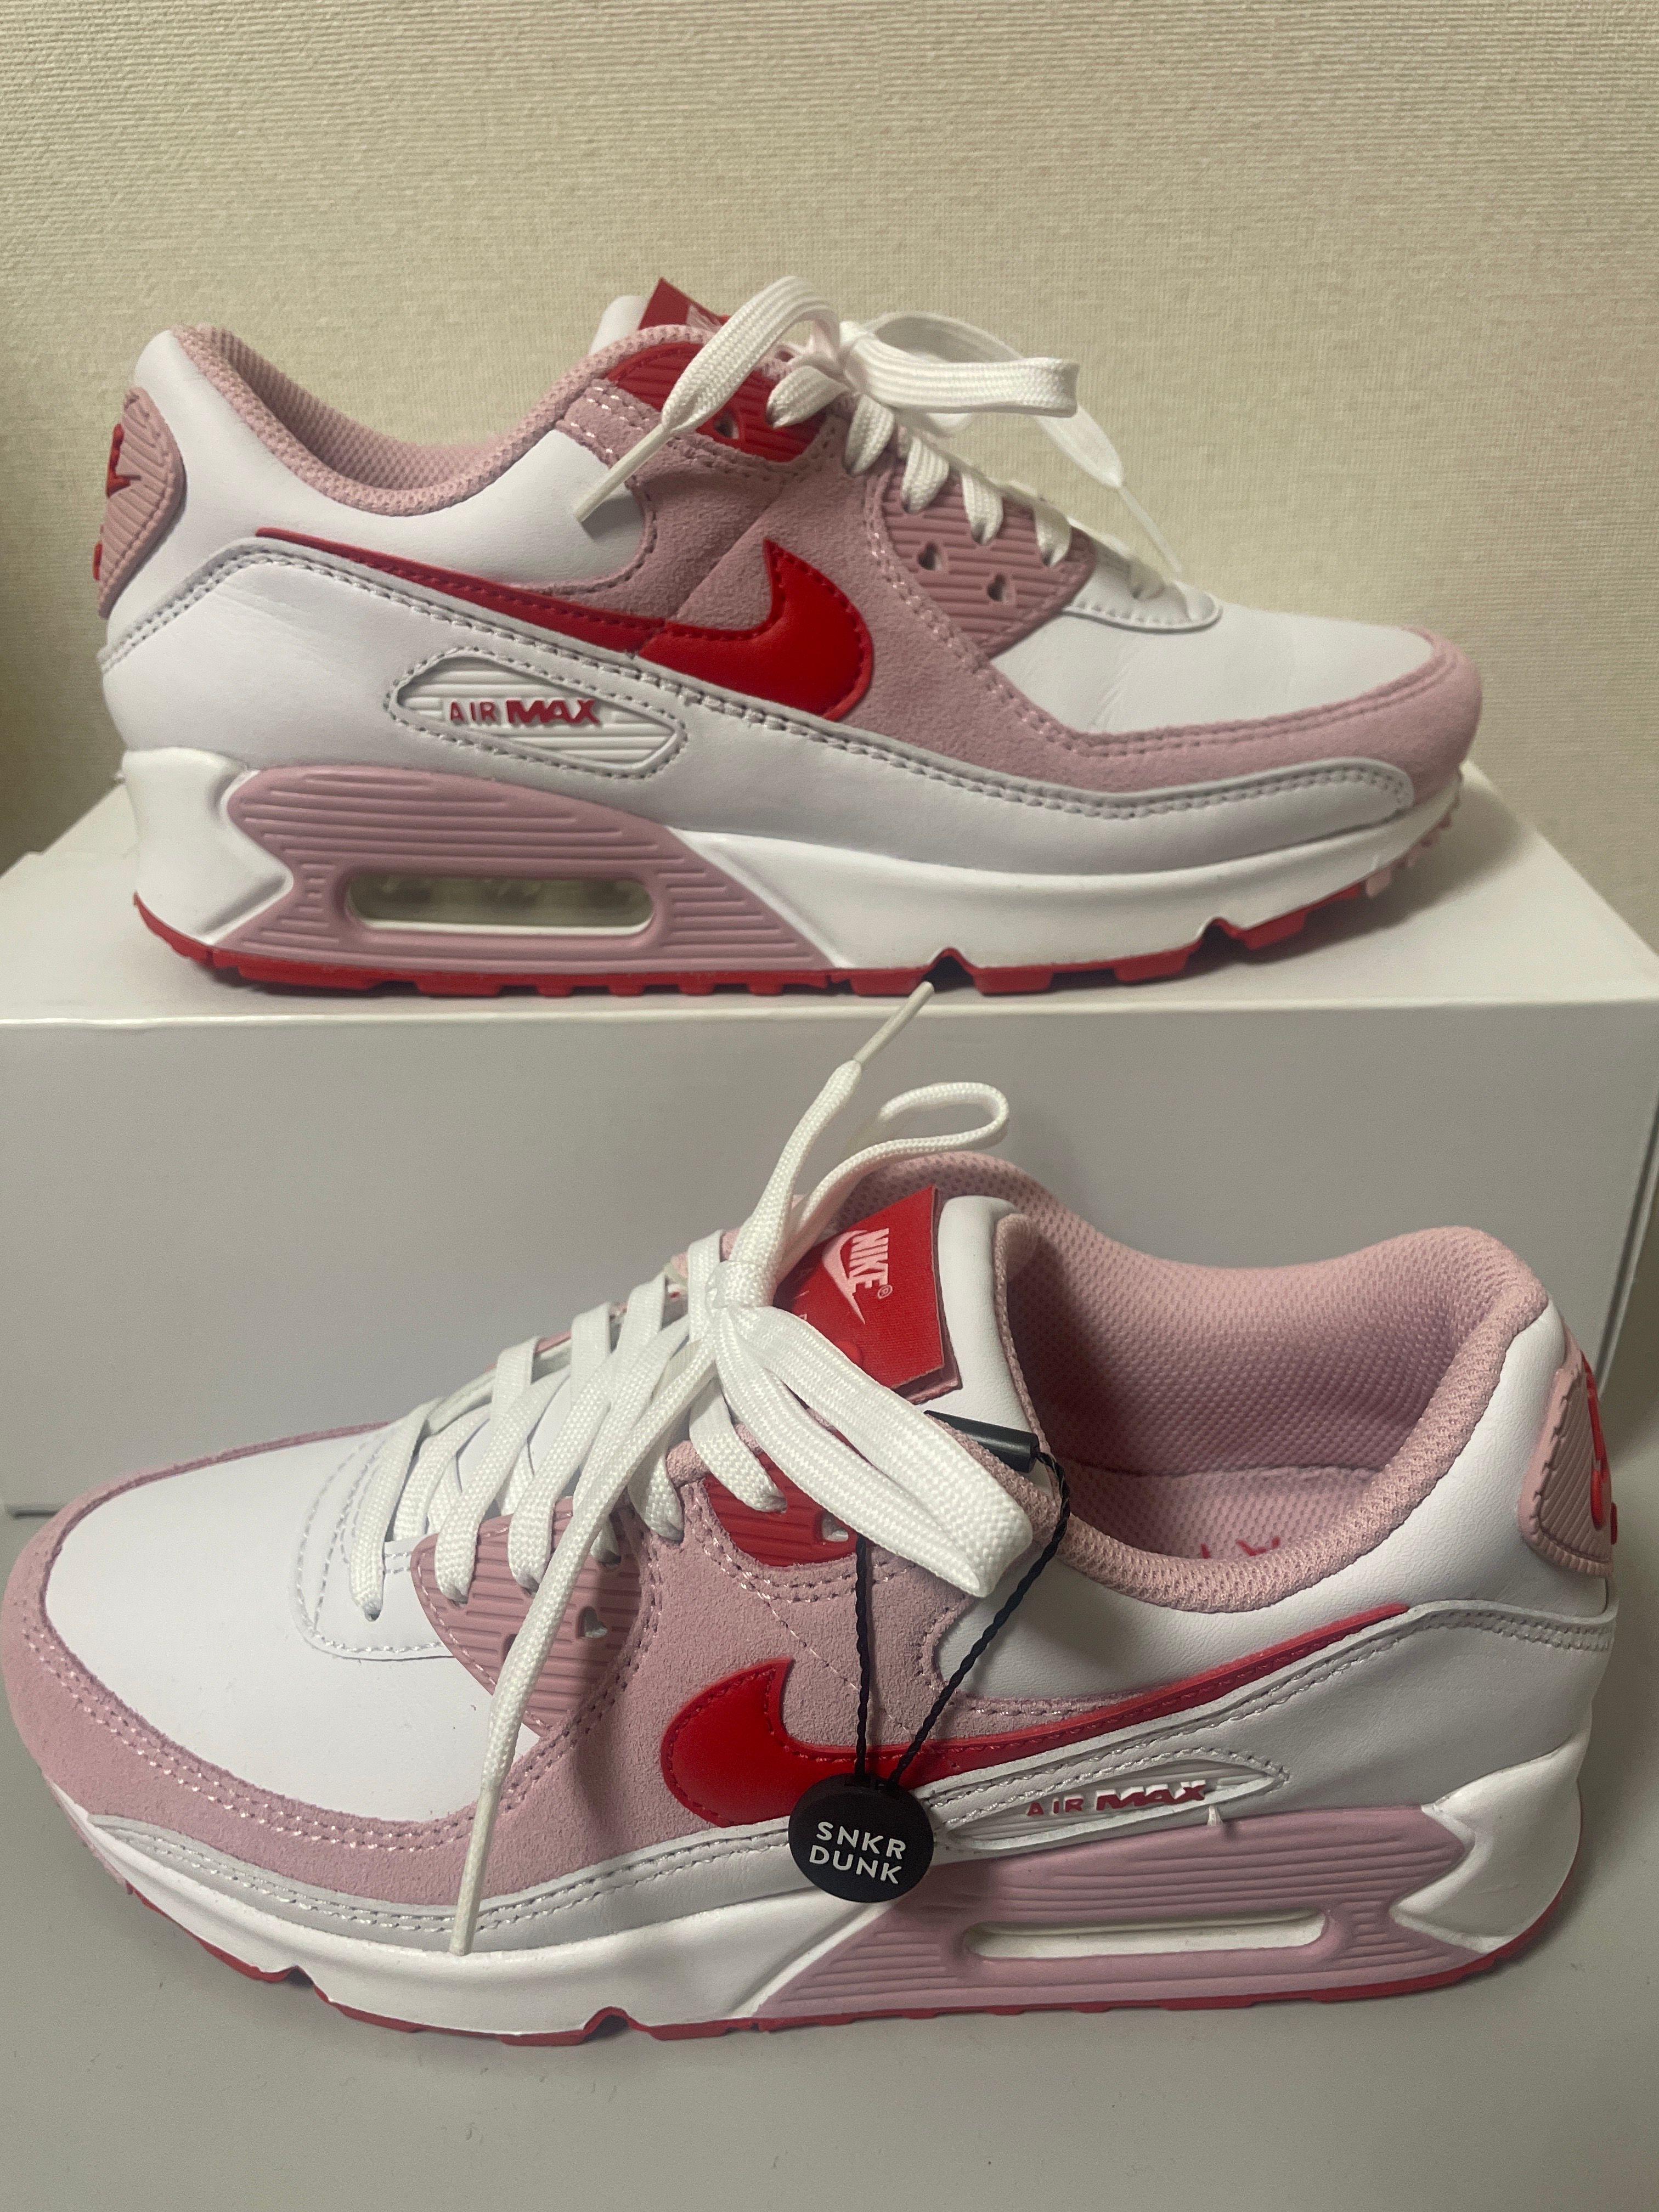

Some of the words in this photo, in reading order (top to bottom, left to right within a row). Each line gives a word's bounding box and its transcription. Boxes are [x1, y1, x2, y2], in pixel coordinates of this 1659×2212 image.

[450, 701, 497, 721] AIR
[506, 699, 600, 724] MAX
[1027, 1798, 1083, 1816] AIR
[1097, 1784, 1205, 1810] MAX
[816, 1821, 906, 1860] SNKR
[809, 1845, 902, 1884] DUNK
